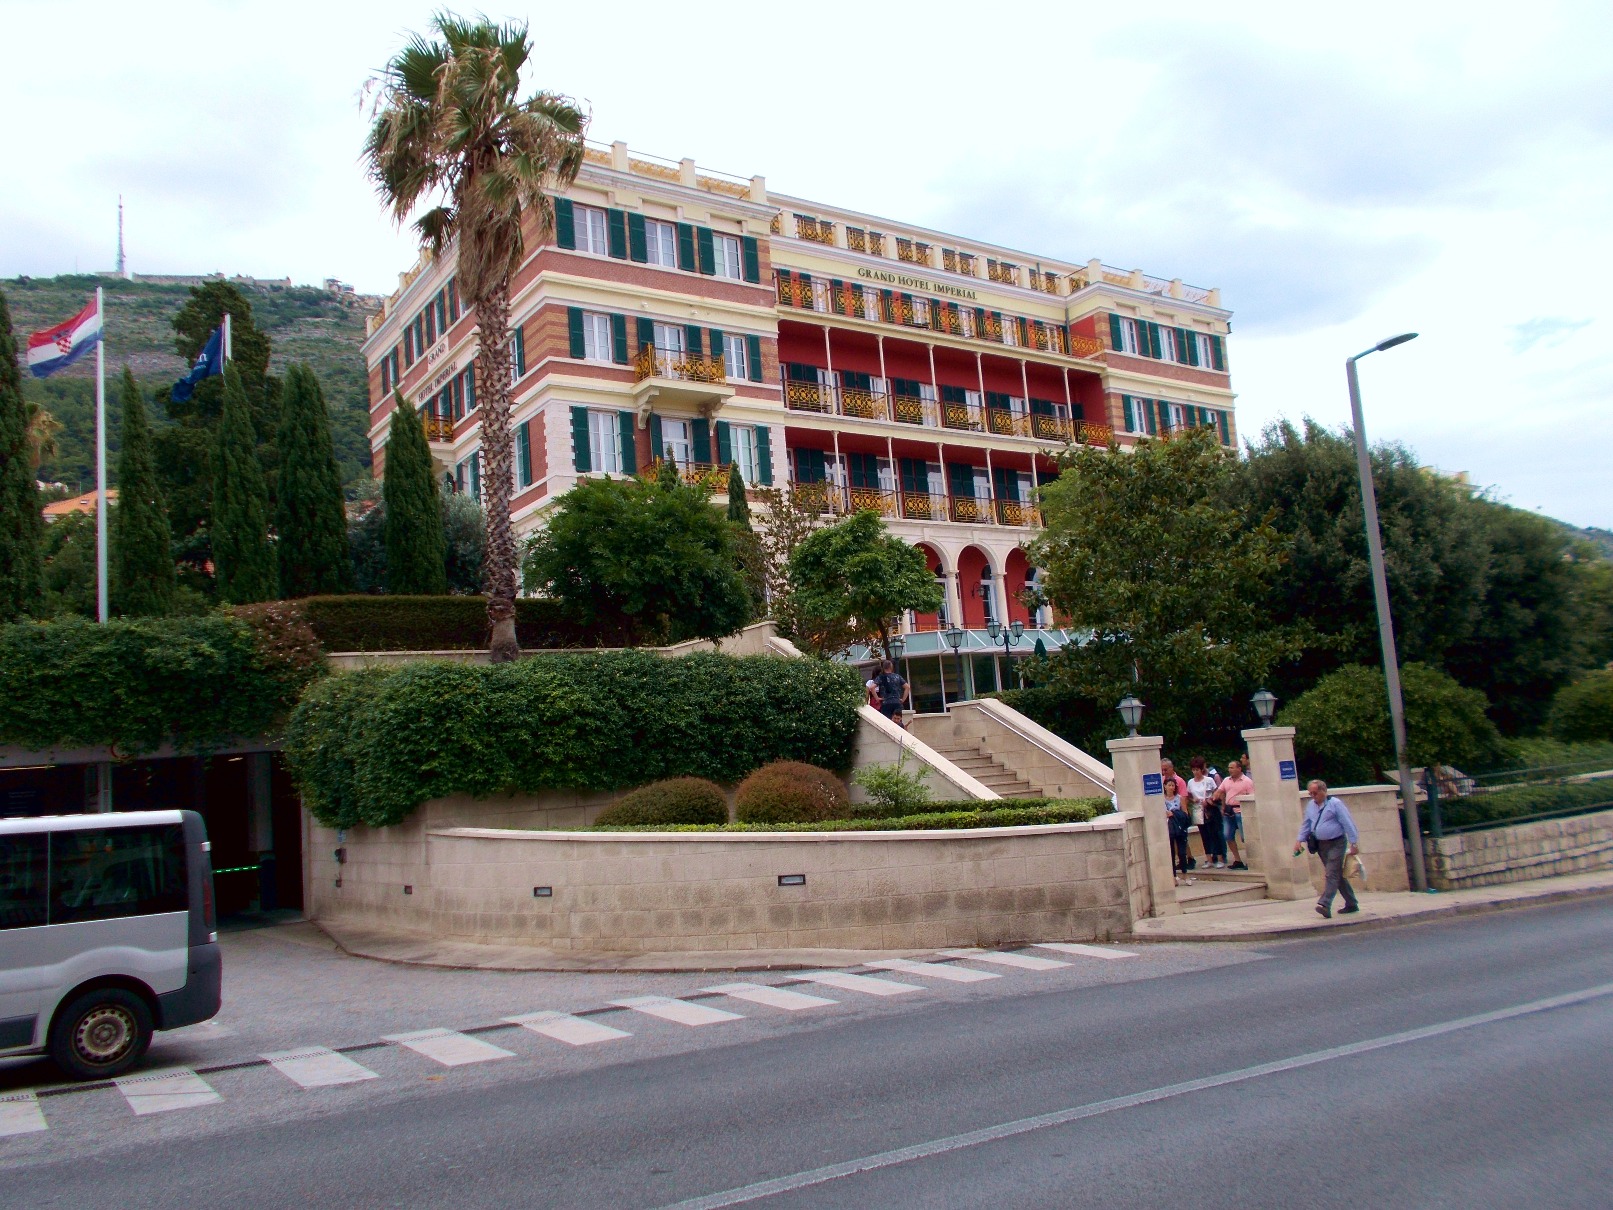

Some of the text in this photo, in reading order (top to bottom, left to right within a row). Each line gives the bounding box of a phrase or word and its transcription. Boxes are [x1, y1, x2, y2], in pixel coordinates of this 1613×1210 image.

[858, 268, 978, 300] GRAND HOTEL IMPERIAL
[418, 361, 458, 402] HOTEL IMPERIAL
